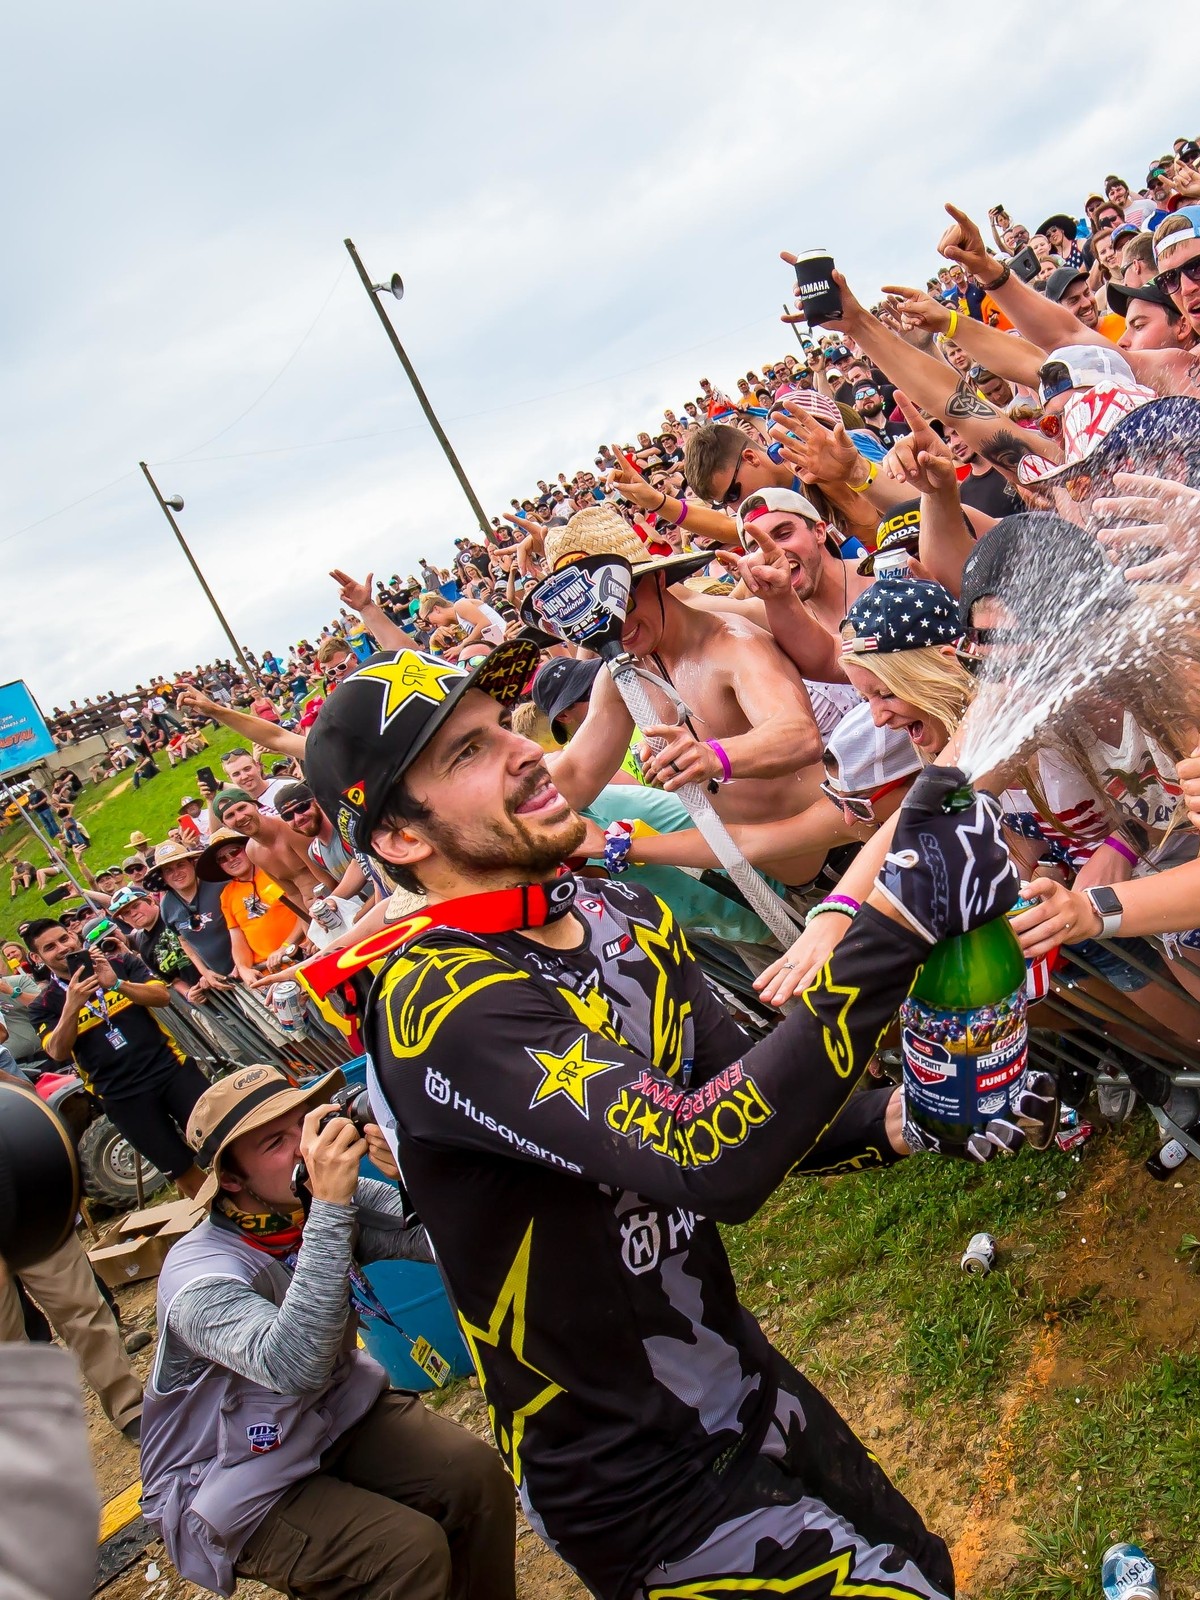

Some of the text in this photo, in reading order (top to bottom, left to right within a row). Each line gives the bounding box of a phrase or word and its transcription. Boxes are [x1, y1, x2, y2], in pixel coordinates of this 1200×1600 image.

[800, 280, 830, 294] YAMAHA
[880, 525, 920, 549] ONDA
[542, 592, 564, 616] HIGH
[560, 577, 589, 604] POINT
[980, 1072, 1007, 1088] JUNE
[347, 1085, 362, 1096] SONY
[453, 1090, 584, 1175] Husqvarna
